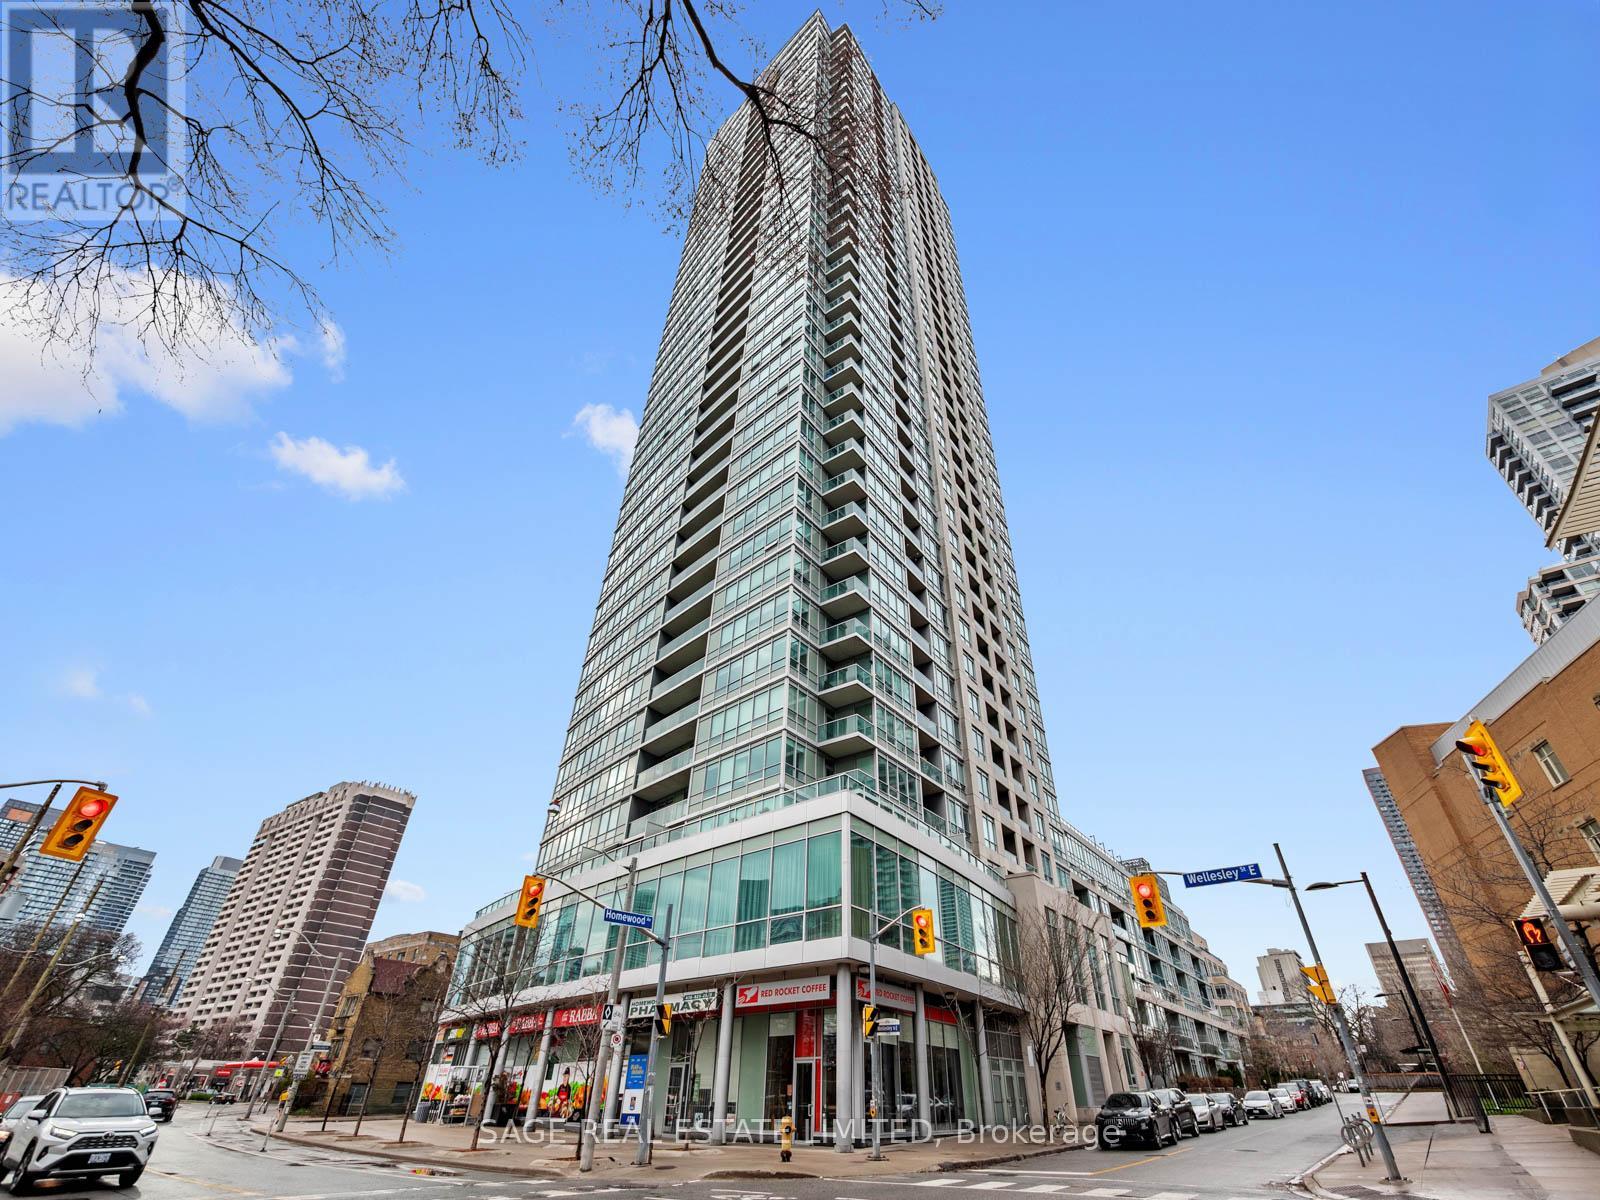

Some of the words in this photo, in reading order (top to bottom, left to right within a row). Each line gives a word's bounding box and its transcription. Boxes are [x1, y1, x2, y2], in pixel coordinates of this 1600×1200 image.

[1187, 868, 1239, 884] Wellesley
[1248, 865, 1257, 876] E
[606, 910, 646, 924] Homewood
[760, 989, 773, 997] RED
[774, 986, 800, 996] ROCKET
[801, 983, 827, 994] COFFEE
[568, 1007, 598, 1023] RABBA
[630, 998, 717, 1016] PHAMACY
